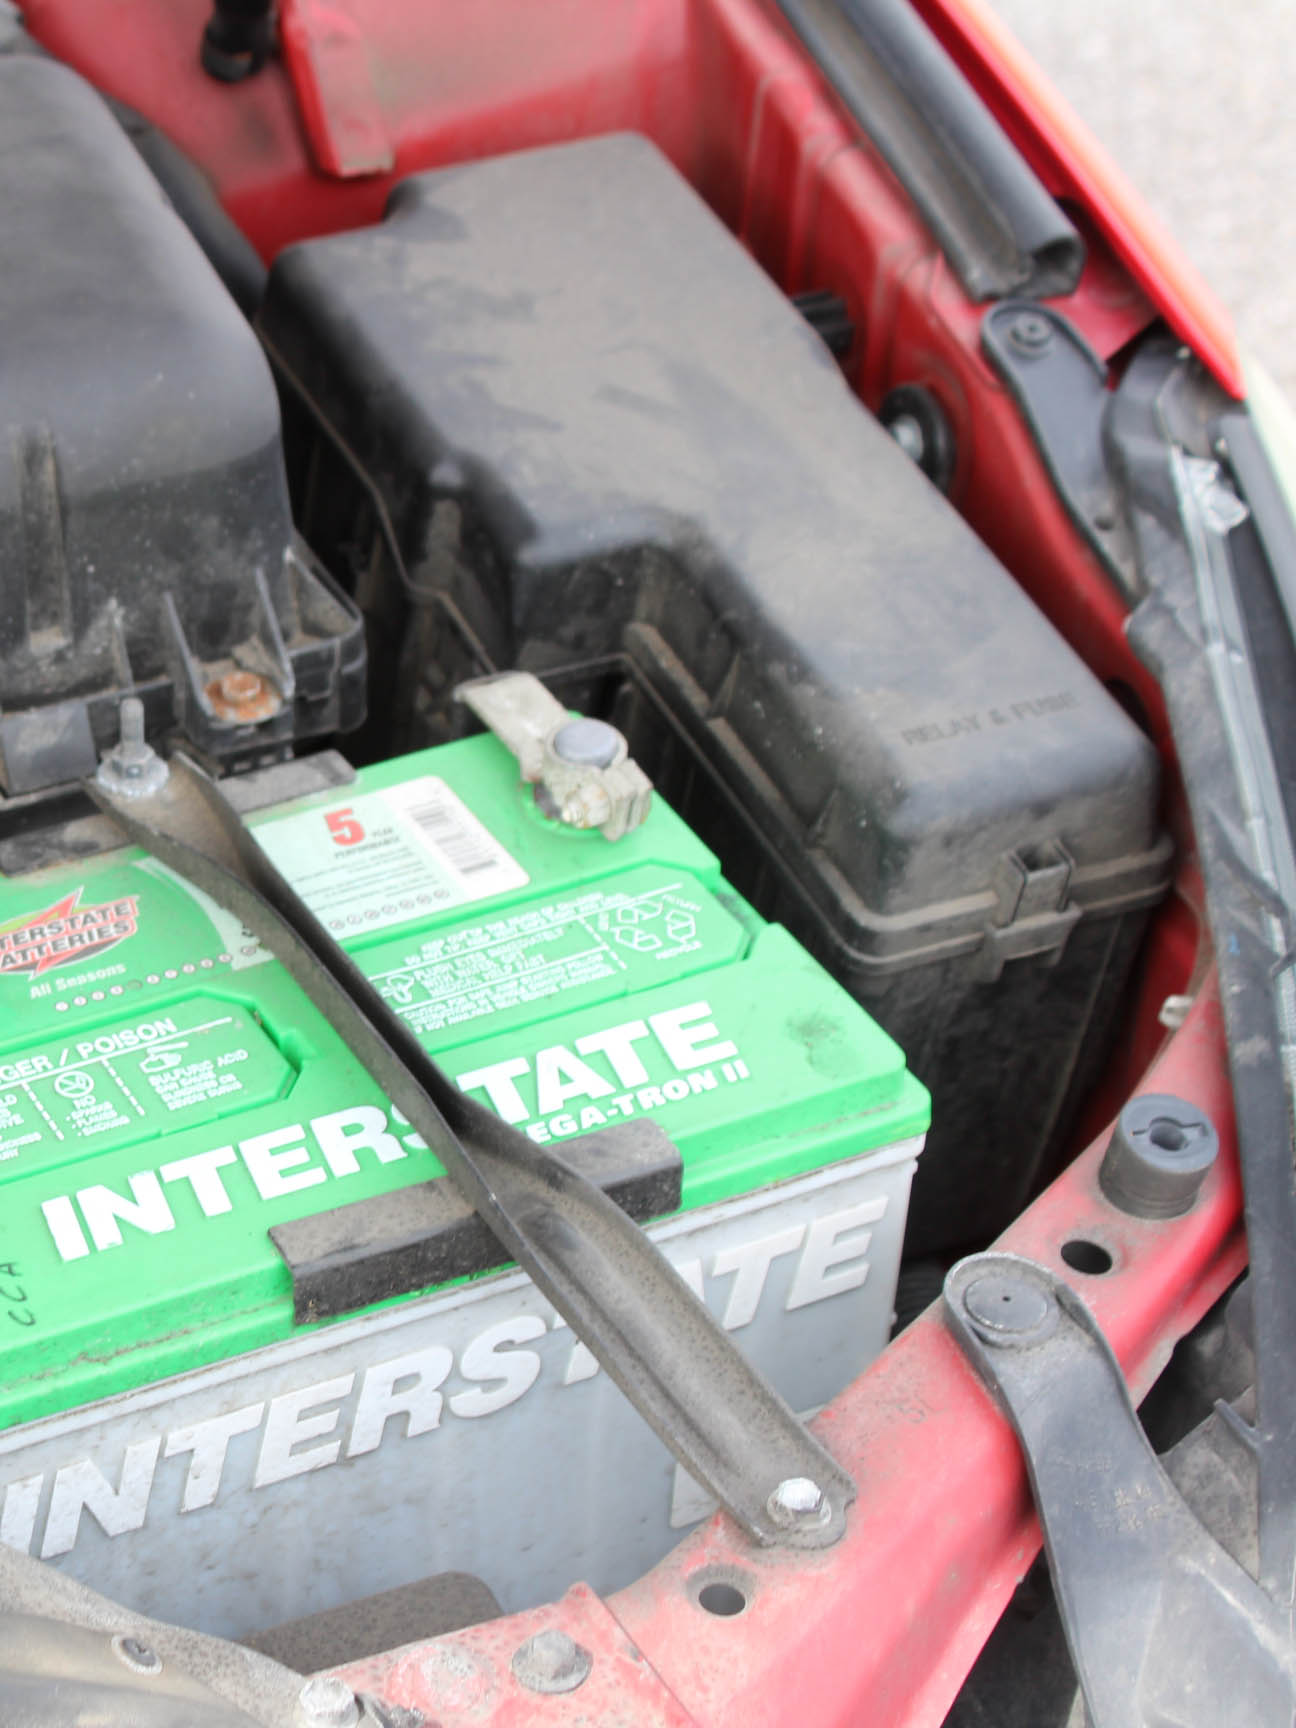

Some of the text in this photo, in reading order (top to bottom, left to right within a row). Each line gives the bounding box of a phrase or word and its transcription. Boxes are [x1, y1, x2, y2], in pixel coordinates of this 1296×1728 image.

[324, 808, 365, 846] 5
[30, 962, 126, 999] All Seasons
[77, 1018, 178, 1059] POISON
[148, 1049, 248, 1086] SULFURIC ACID
[73, 1095, 96, 1109] NO
[524, 1059, 750, 1145] EGA-TRON II
